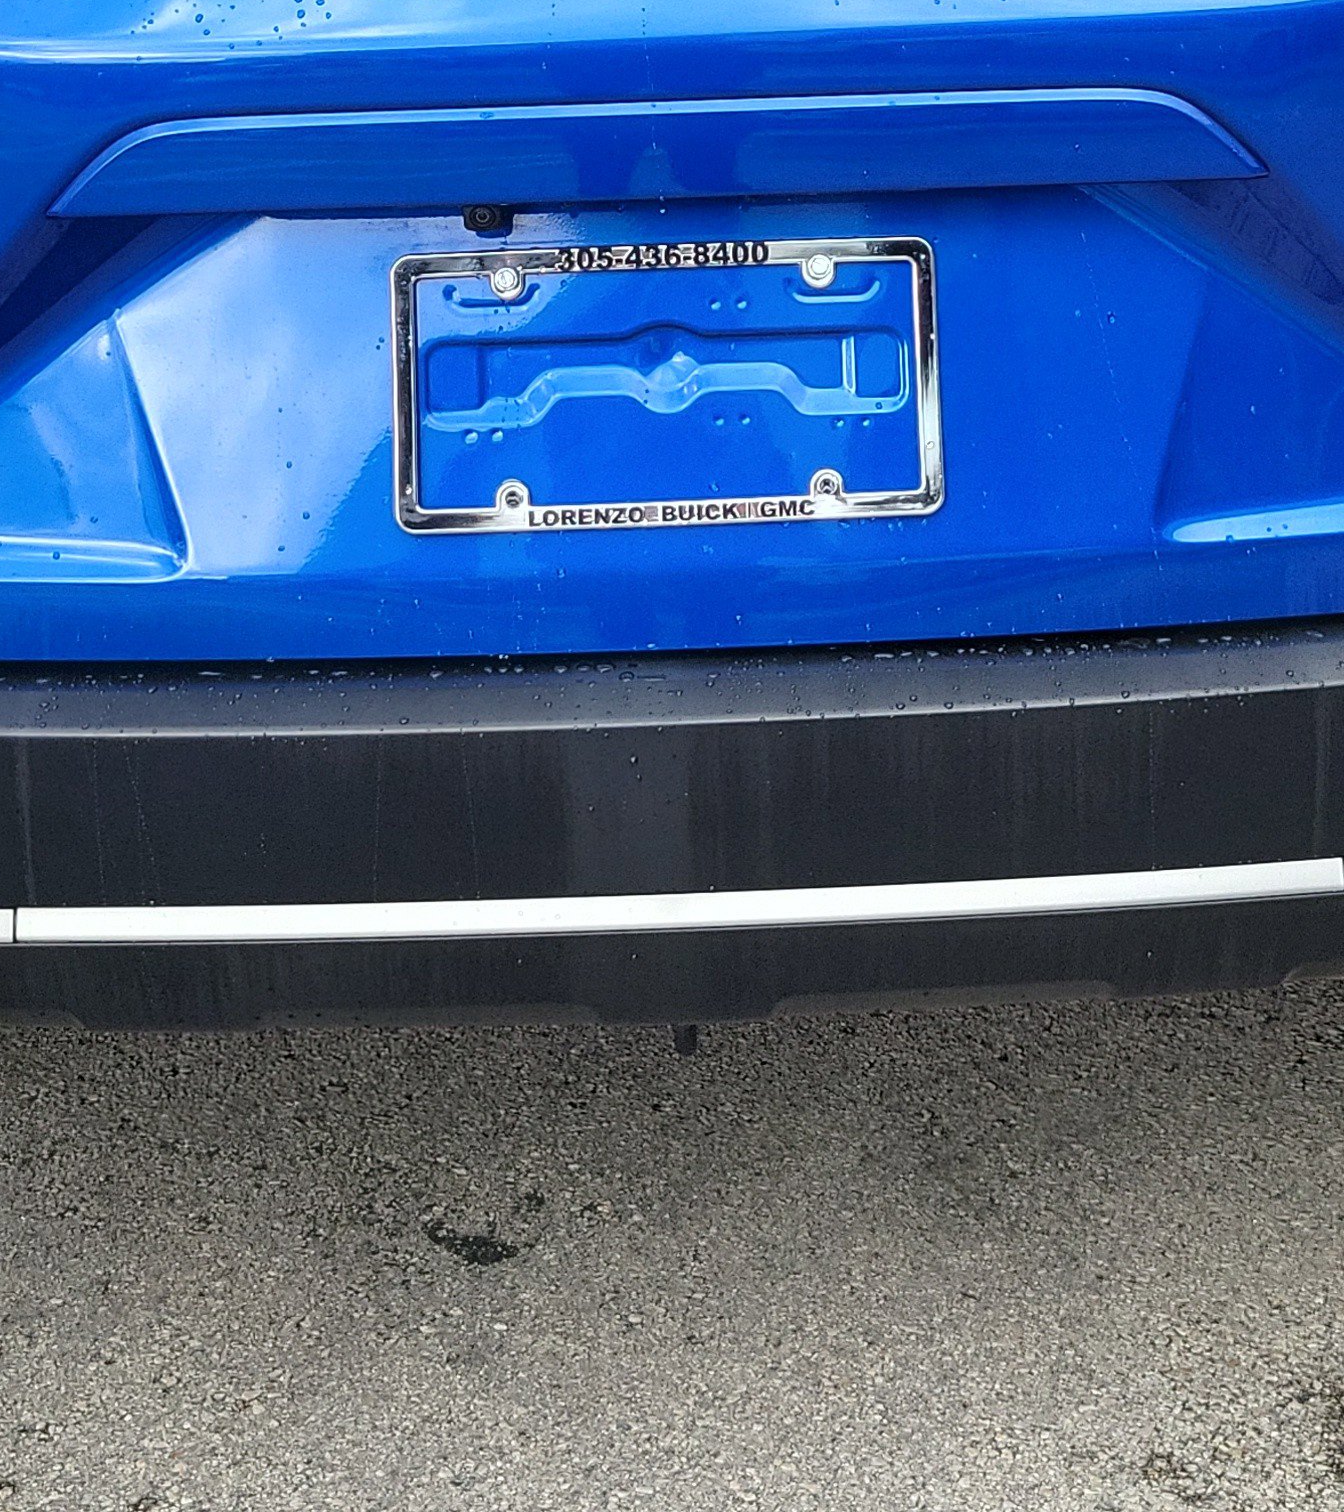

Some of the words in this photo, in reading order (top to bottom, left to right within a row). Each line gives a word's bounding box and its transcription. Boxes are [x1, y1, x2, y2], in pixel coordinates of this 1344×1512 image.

[557, 241, 770, 272] 305-436-8400
[527, 506, 646, 528] LORENZO
[661, 502, 739, 523] BUICK
[759, 498, 817, 518] GMC
